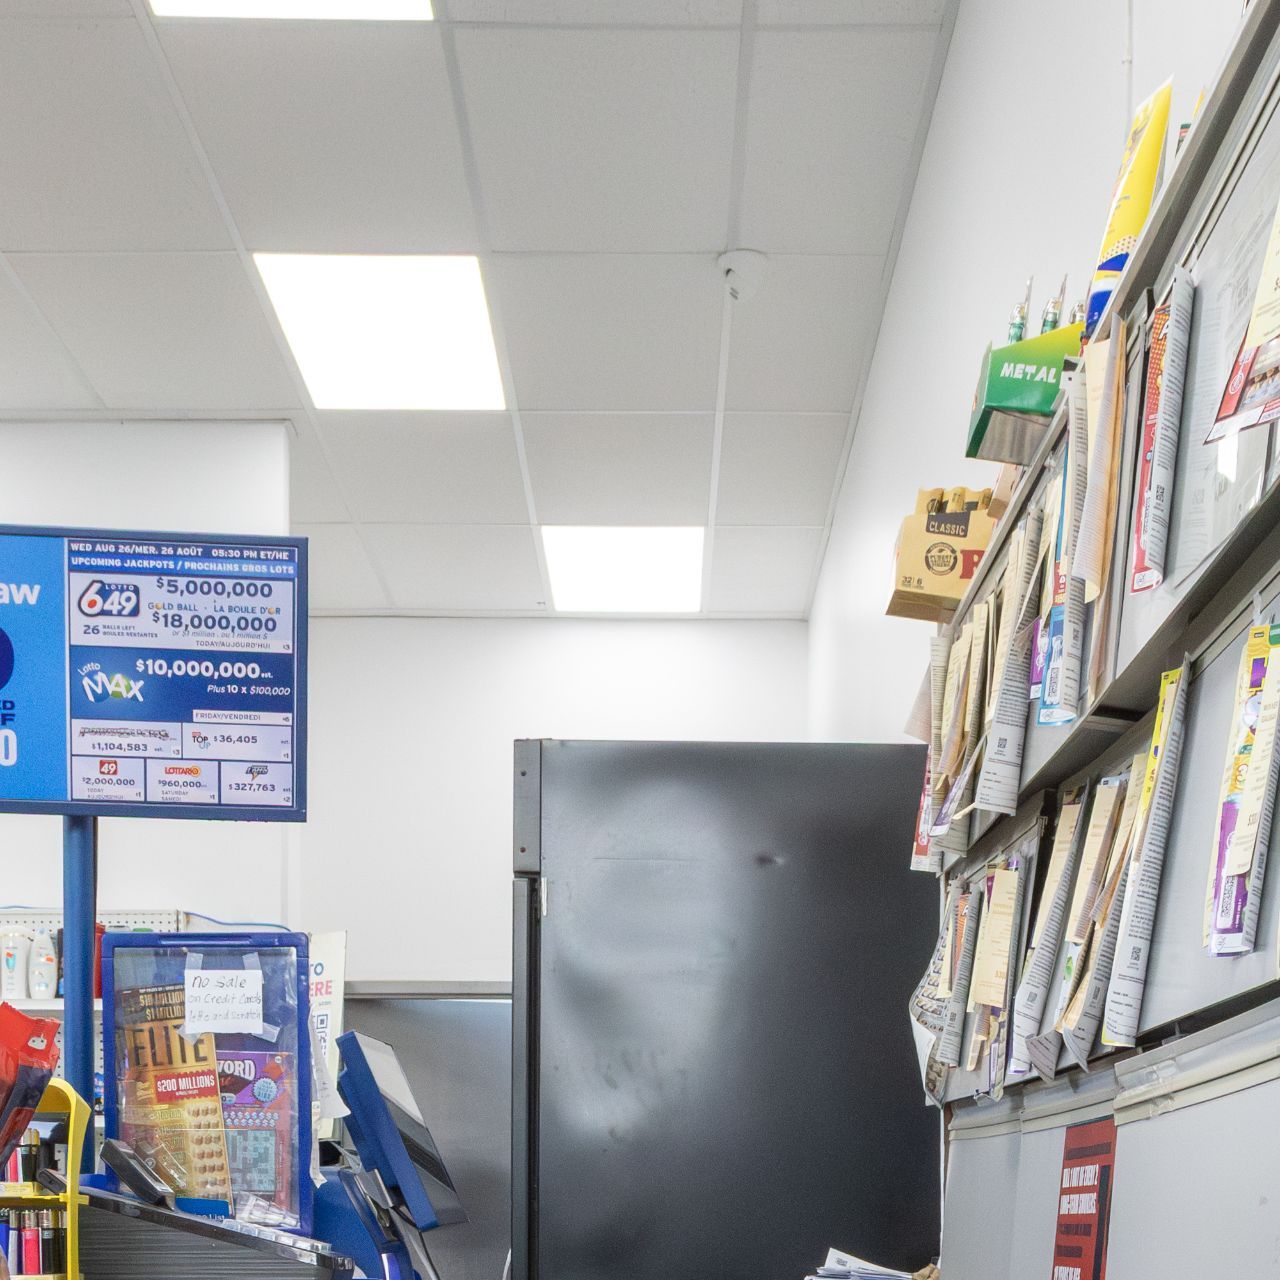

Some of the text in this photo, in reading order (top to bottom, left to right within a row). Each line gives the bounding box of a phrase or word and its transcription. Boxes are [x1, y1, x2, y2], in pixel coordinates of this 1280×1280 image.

[1000, 361, 1057, 384] METAL
[929, 521, 966, 536] CLASSIC
[70, 543, 92, 552] WED
[95, 544, 116, 553] AUG
[161, 547, 174, 555] 26
[212, 549, 241, 558] 05:30
[243, 550, 258, 559] PM
[260, 551, 289, 560] ET/HE
[71, 557, 122, 568] UPCOMING
[124, 560, 175, 570] JACKPOTS
[184, 562, 240, 573] PROCHAINS
[242, 564, 268, 574] GROS
[270, 565, 294, 575] LOTS
[105, 583, 135, 591] LOTTO
[156, 576, 273, 599] $5,000,000
[177, 603, 199, 612] BALL
[213, 604, 225, 614] LA
[227, 605, 257, 615] BOULE
[83, 624, 100, 635] 26
[152, 611, 277, 633] $18,000,000
[77, 661, 101, 676] Lotto
[135, 659, 260, 679] $10,000,000
[82, 671, 144, 703] MAX
[207, 684, 226, 694] Plus
[226, 684, 239, 694] 10
[250, 686, 291, 696] $100,000
[195, 713, 261, 721] FRIDAY/VENDREDI
[100, 761, 118, 775] 49
[82, 776, 135, 787] $2,000,000
[158, 779, 201, 789] $960,000
[229, 783, 276, 793] $327,763
[157, 1075, 215, 1092] $200 MILLIONS
